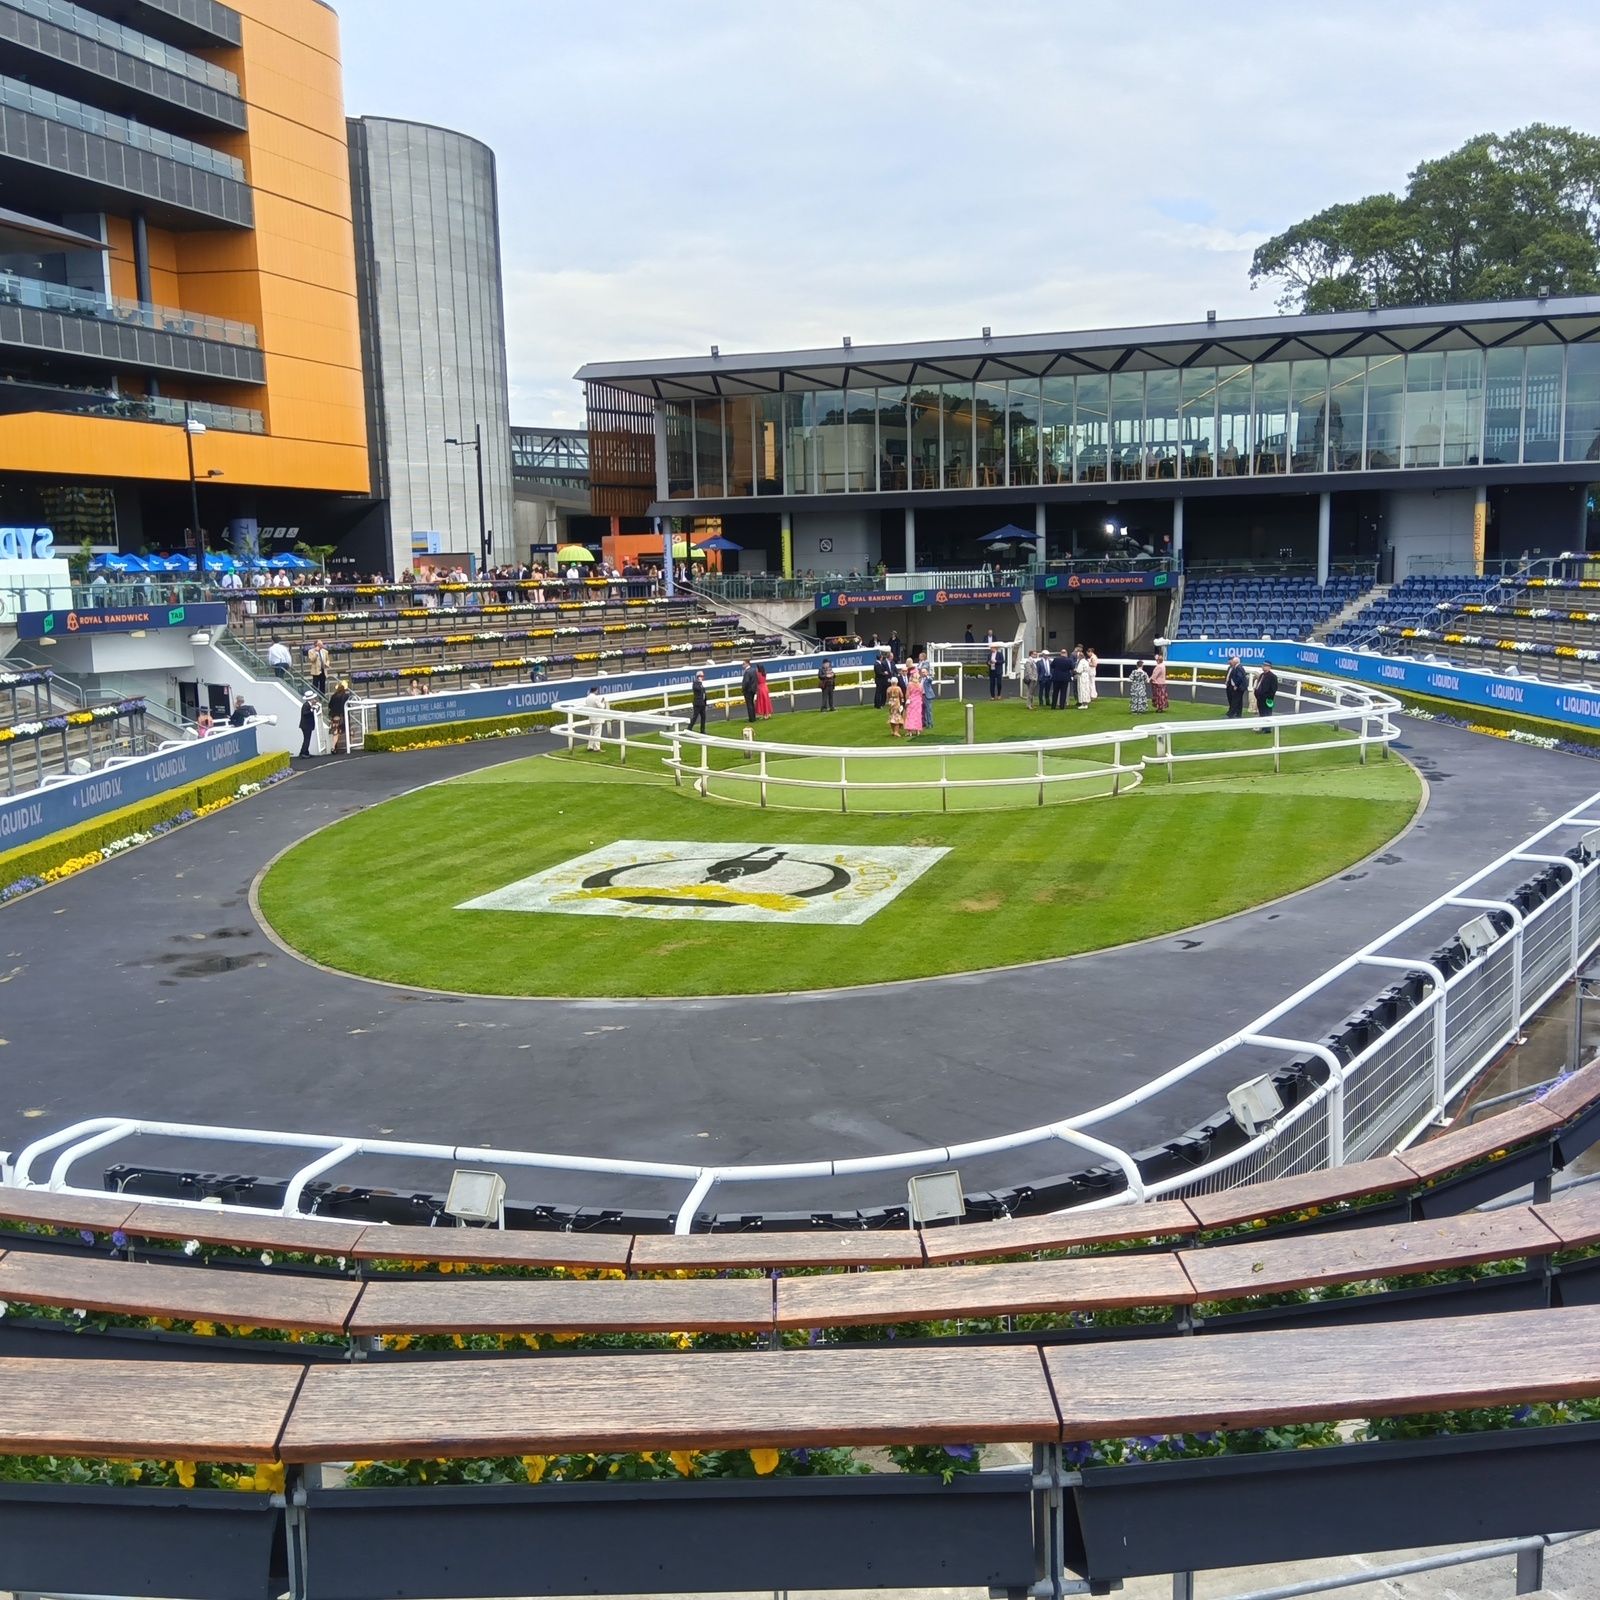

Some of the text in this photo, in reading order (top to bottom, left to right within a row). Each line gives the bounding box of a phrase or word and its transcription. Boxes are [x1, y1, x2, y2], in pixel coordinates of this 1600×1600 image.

[868, 594, 903, 602] RANDWICK
[79, 613, 149, 625] ROYAL RANDWICK
[170, 612, 183, 620] TAB
[1219, 648, 1253, 659] LIQUID
[1381, 665, 1399, 679] LIQUID
[1432, 673, 1452, 689] LIQUID
[1491, 683, 1515, 701] LIQUID
[385, 700, 457, 715] ALWAYS READ THE LABEL AND
[515, 693, 548, 708] LIQUID
[1562, 695, 1591, 716] LIQUID
[386, 709, 466, 726] FOLLOW THE DIRECTIONS FOR USE
[211, 740, 232, 762] LIQUID
[152, 758, 178, 783] LIQUID
[81, 780, 111, 808] LIQUID
